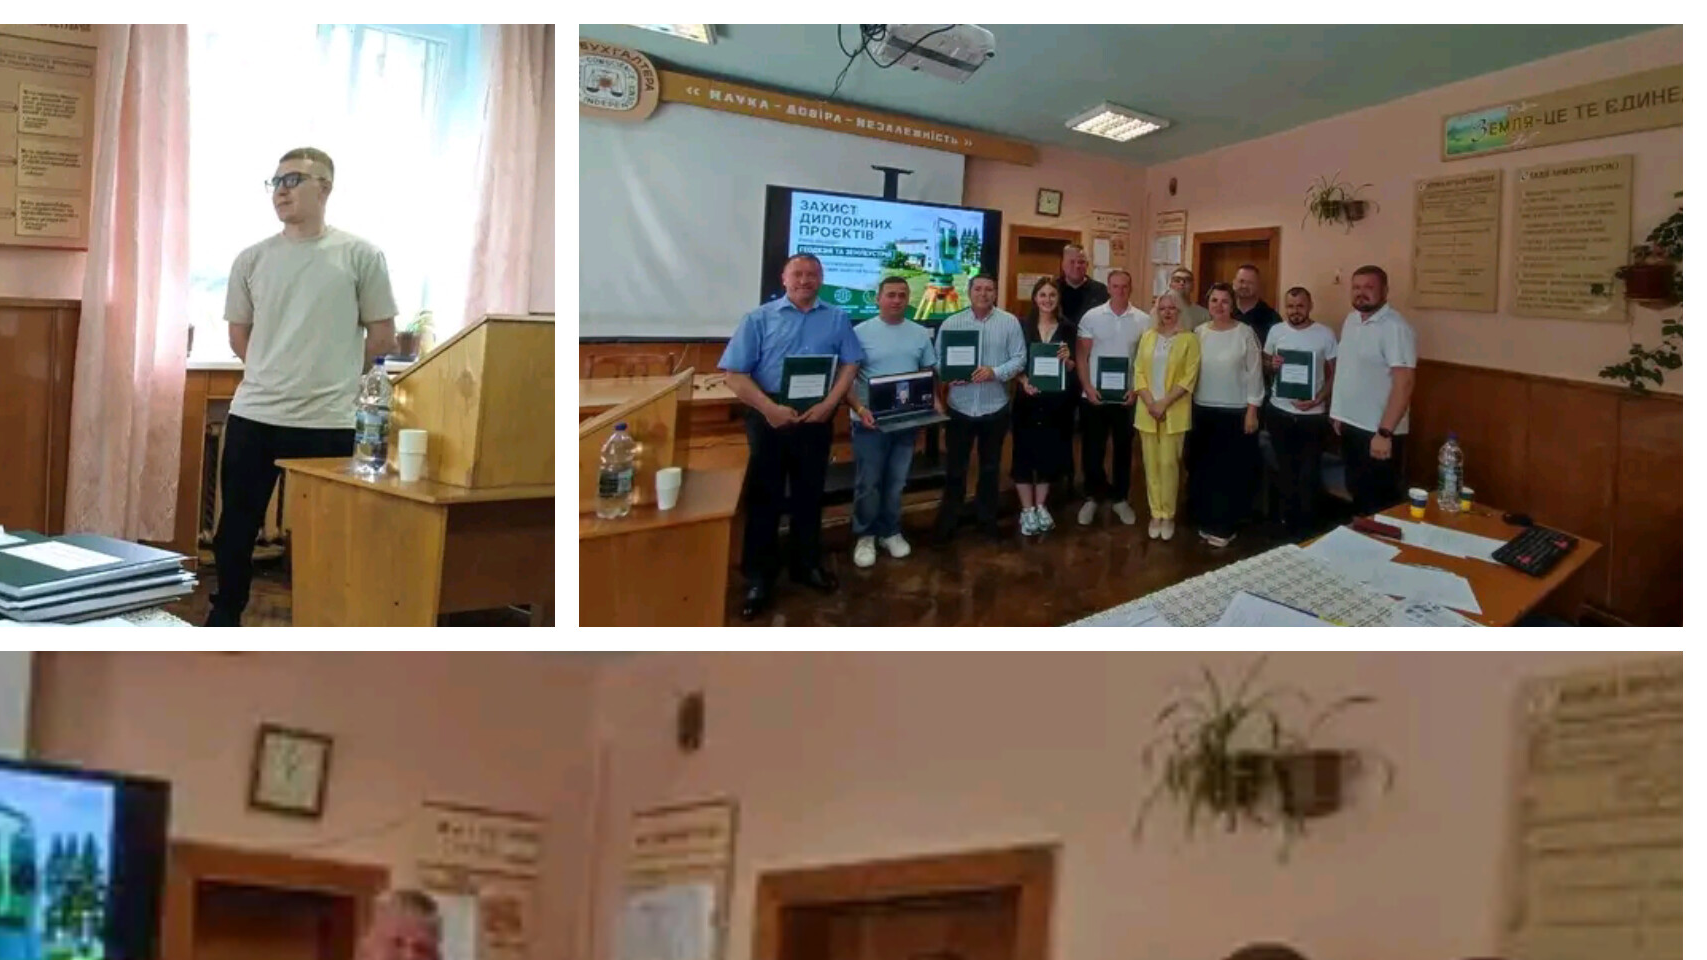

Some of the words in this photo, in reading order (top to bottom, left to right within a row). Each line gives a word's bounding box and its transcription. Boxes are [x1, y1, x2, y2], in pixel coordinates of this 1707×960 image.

[709, 89, 769, 109] НАУКА
[786, 104, 842, 123] ДОВІРА
[856, 117, 958, 144] НЕЗАЛЕЖНІСТЬ
[1575, 102, 1599, 120] ТЕ
[800, 200, 857, 215] ЗАХИСТ
[799, 212, 892, 230] ДИПЛОМНИХ
[799, 225, 874, 240] ПРОЄКТІВ
